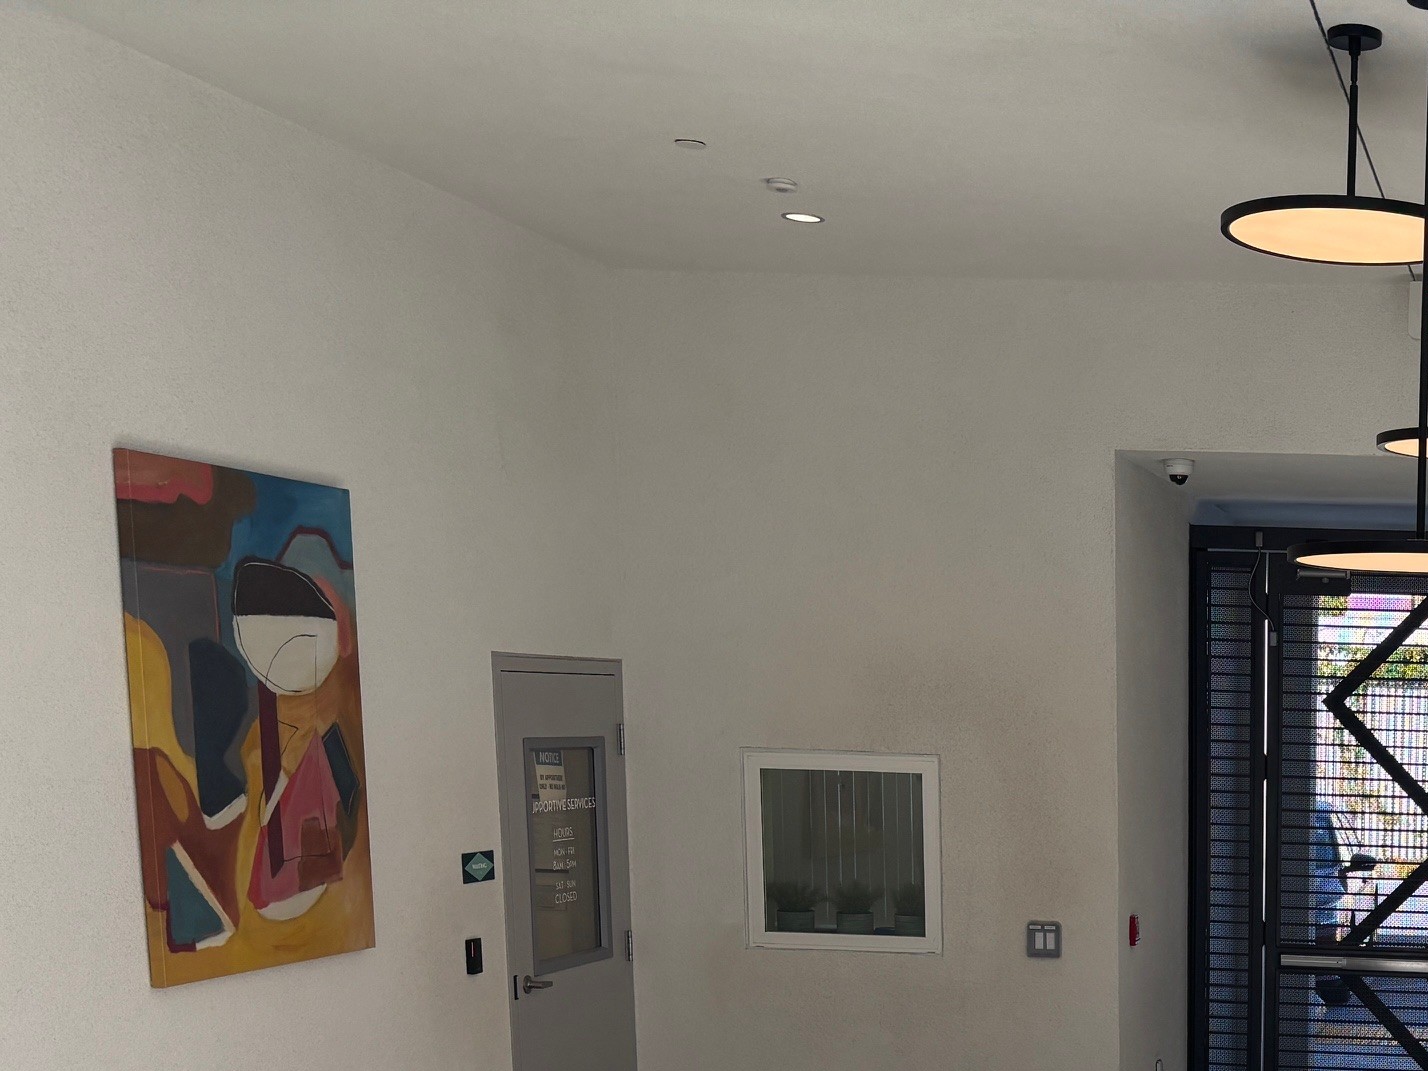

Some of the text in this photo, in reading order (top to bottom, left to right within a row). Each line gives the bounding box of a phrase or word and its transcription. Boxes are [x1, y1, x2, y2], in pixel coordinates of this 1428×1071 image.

[540, 751, 560, 764] NOTICE
[532, 796, 596, 814] PPORTIVE SERVICES
[553, 826, 574, 838] HOURS
[553, 848, 566, 856] MON
[555, 891, 578, 904] CLOSED
